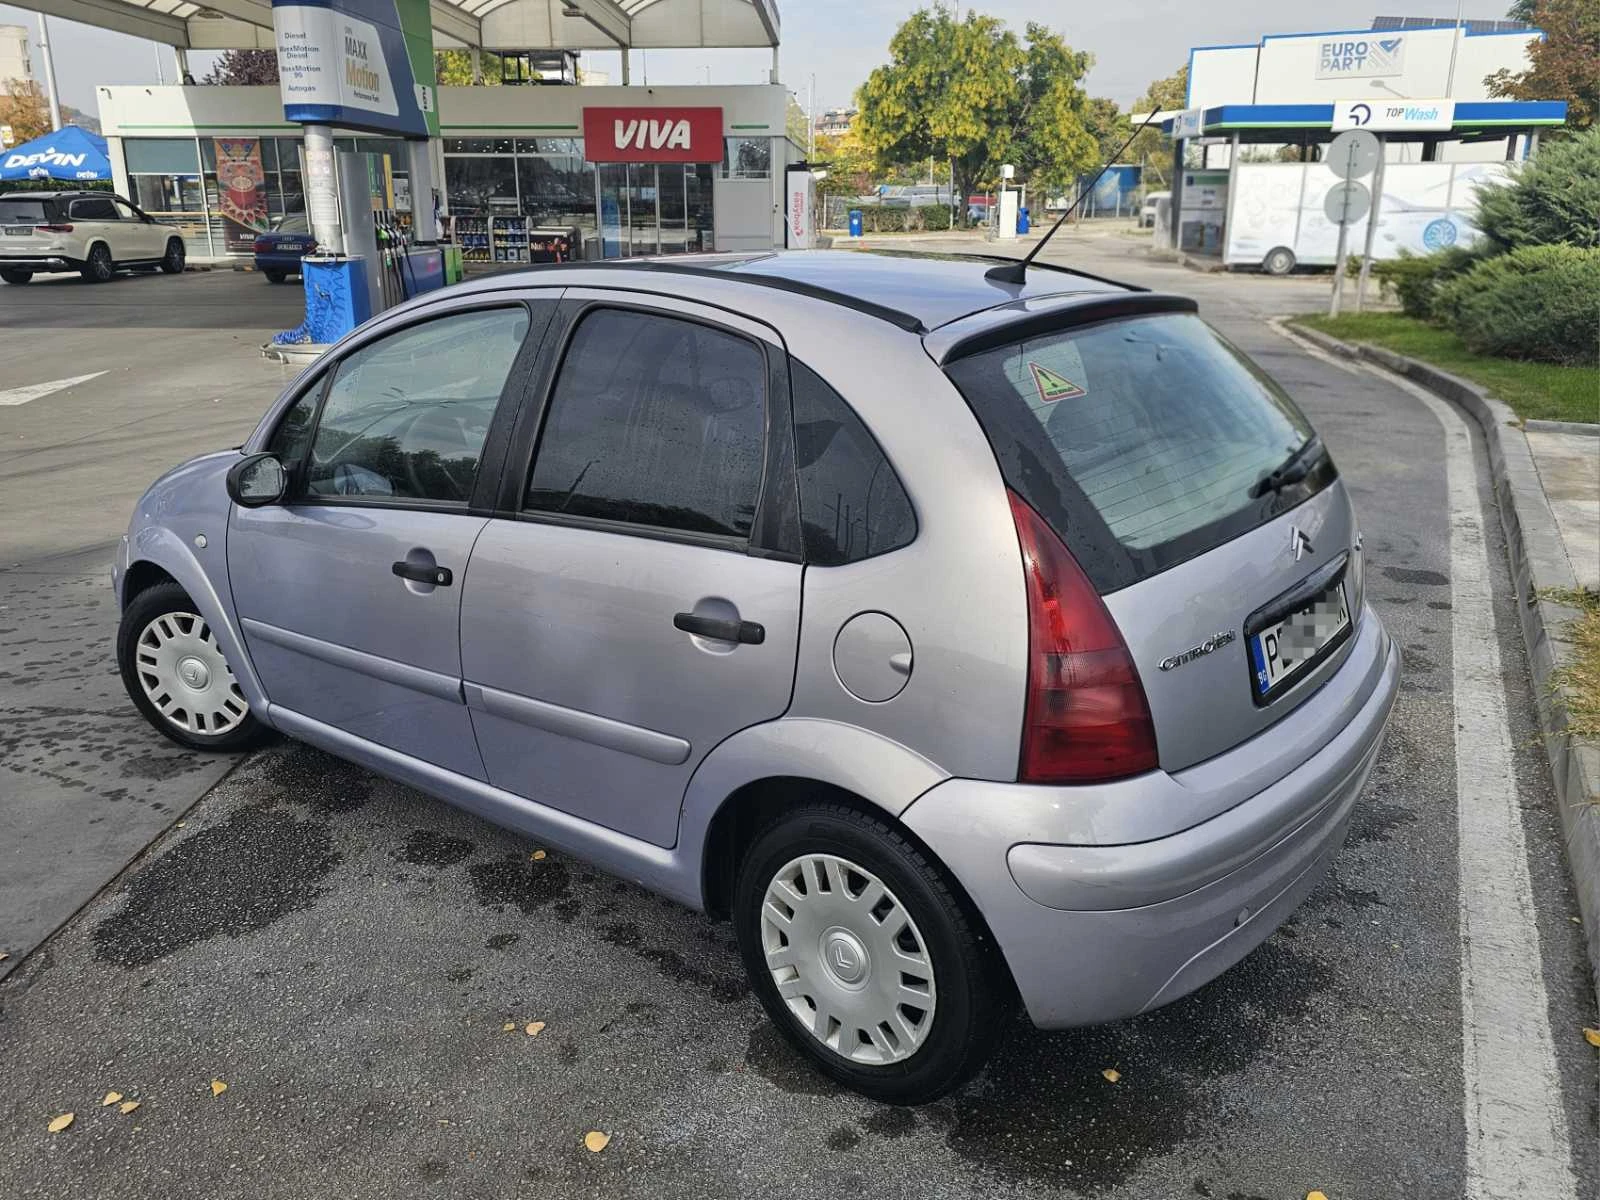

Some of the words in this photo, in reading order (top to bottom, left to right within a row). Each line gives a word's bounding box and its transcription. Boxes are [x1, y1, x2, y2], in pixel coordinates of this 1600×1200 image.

[345, 36, 368, 60] MAXX
[1321, 41, 1368, 58] EURO
[345, 58, 380, 92] Motion
[1320, 57, 1367, 72] PART
[614, 119, 691, 149] VIVA
[5, 147, 86, 168] DEVIN
[76, 170, 98, 178] DEVIN
